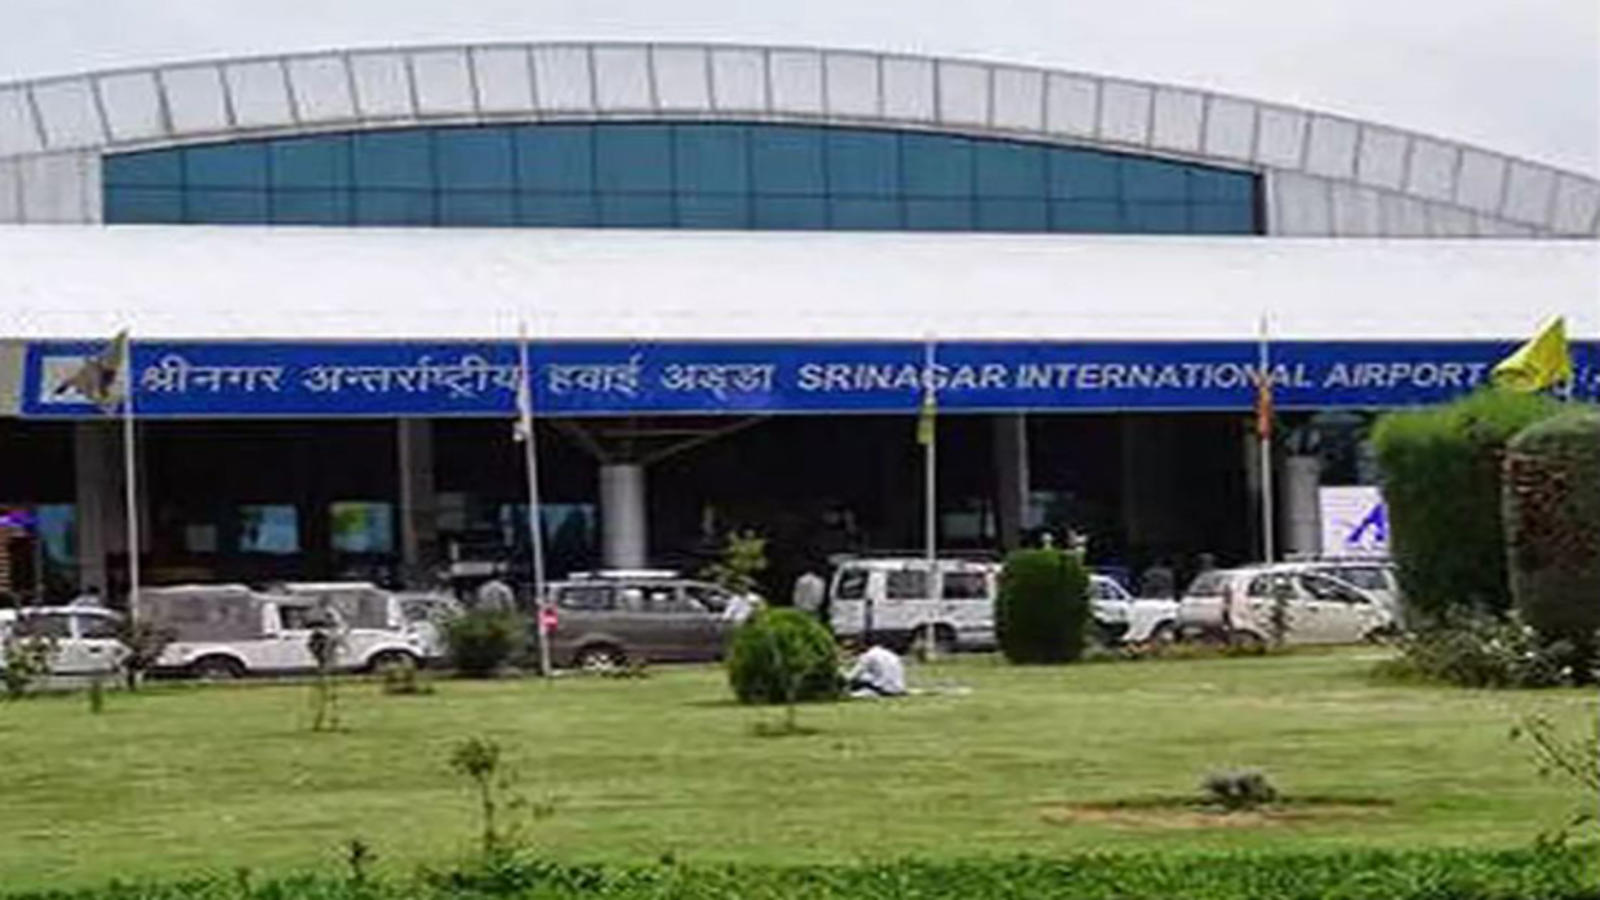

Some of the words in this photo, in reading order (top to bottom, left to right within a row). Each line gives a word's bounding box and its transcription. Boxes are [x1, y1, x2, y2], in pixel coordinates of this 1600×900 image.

[141, 353, 284, 392] श्रीनगर
[548, 353, 643, 394] हवाई
[797, 362, 1008, 391] SRINAGAR
[1016, 361, 1313, 390] INTERNATIONAL
[1323, 361, 1487, 389] AIRPORT
